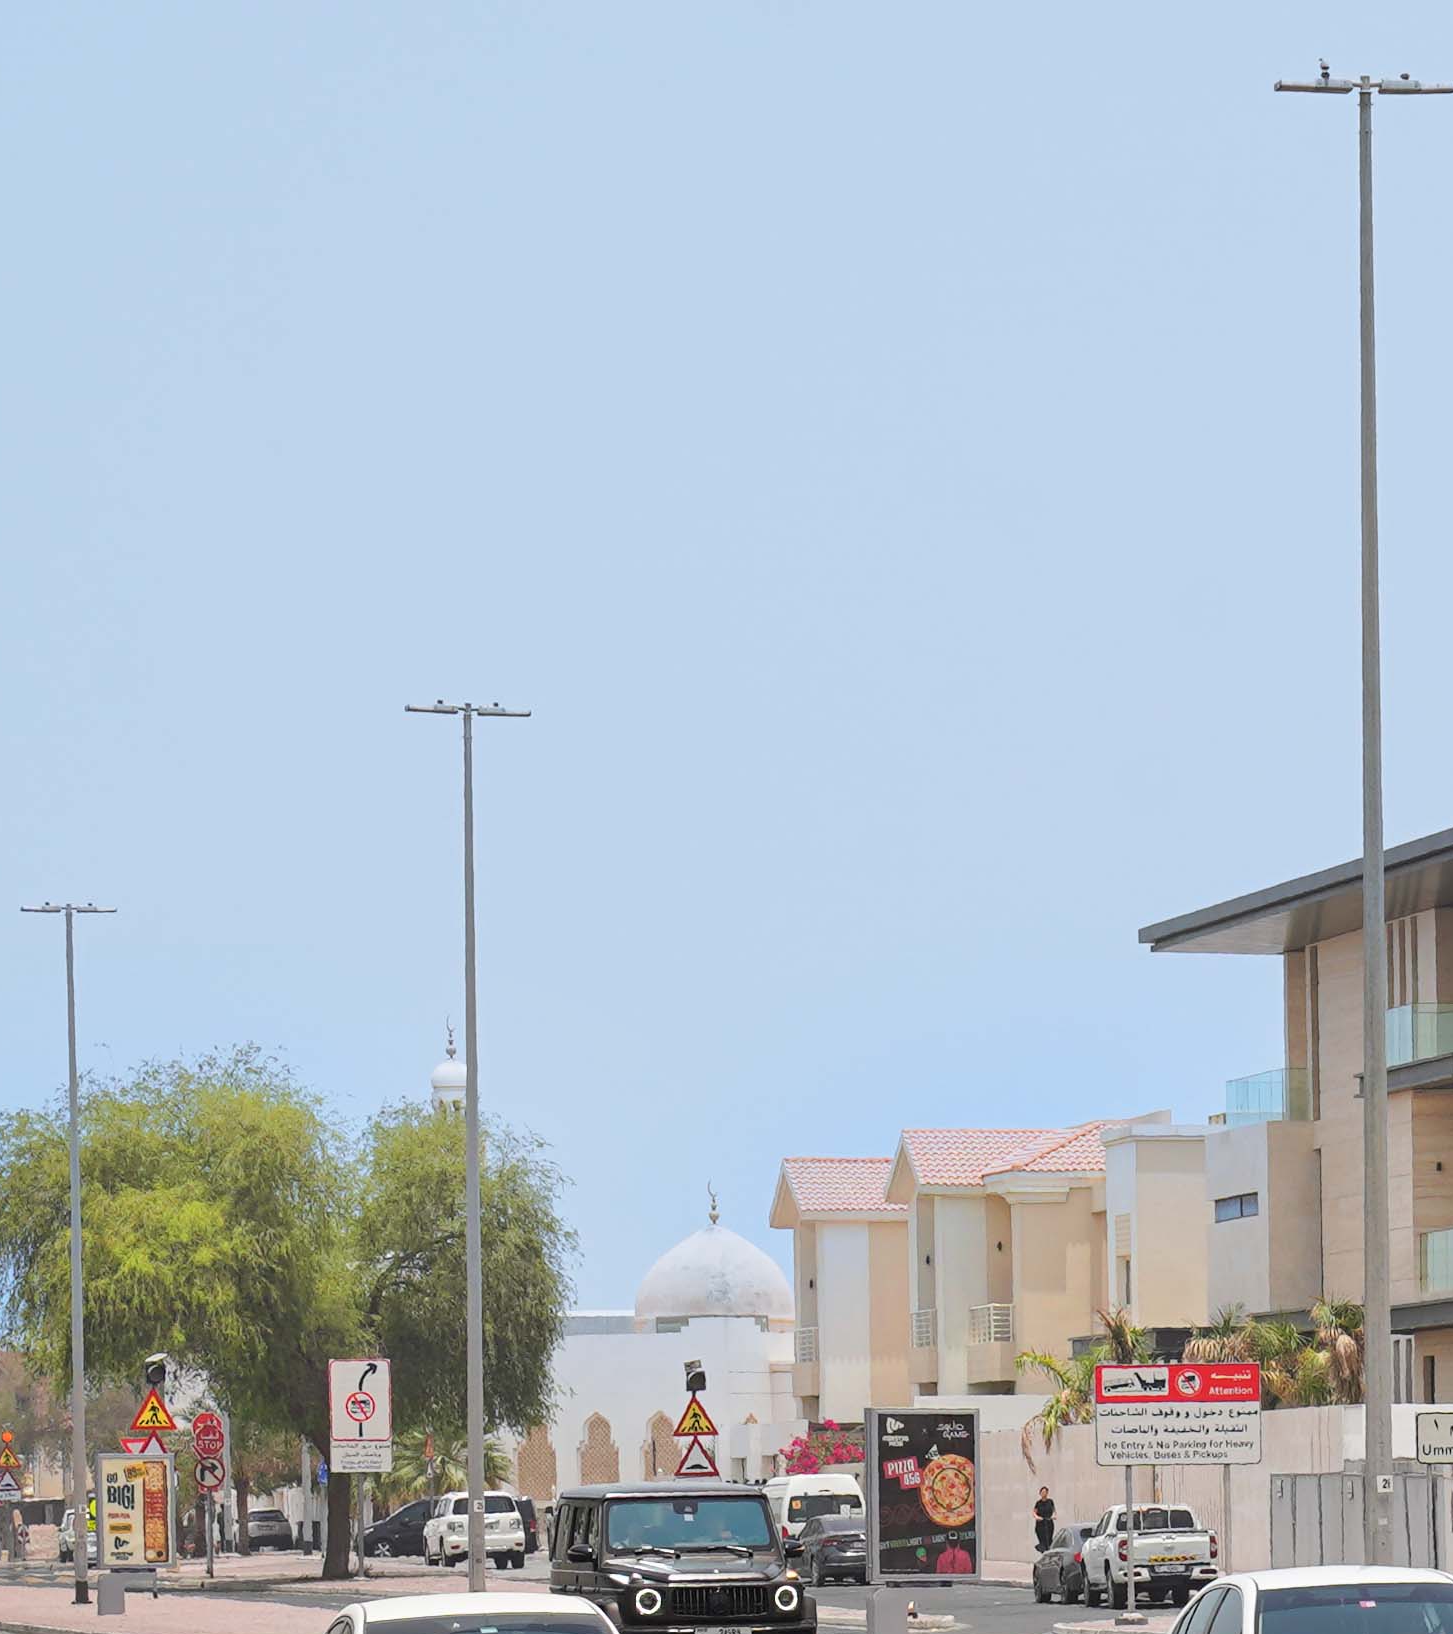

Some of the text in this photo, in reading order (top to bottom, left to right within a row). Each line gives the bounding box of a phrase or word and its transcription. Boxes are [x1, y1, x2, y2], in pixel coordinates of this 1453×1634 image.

[1208, 1385, 1253, 1395] Attention
[1194, 1407, 1223, 1418] دخول
[197, 1440, 221, 1449] STOP
[1104, 1440, 1117, 1449] No
[1120, 1441, 1145, 1451] Entry
[1156, 1440, 1170, 1449] No
[1173, 1439, 1207, 1450] Parking
[1209, 1439, 1222, 1448] for
[1225, 1439, 1254, 1449] Heavy
[1153, 1451, 1181, 1459] Buses
[1193, 1450, 1228, 1460] Pickups
[107, 1484, 135, 1511] BIG!
